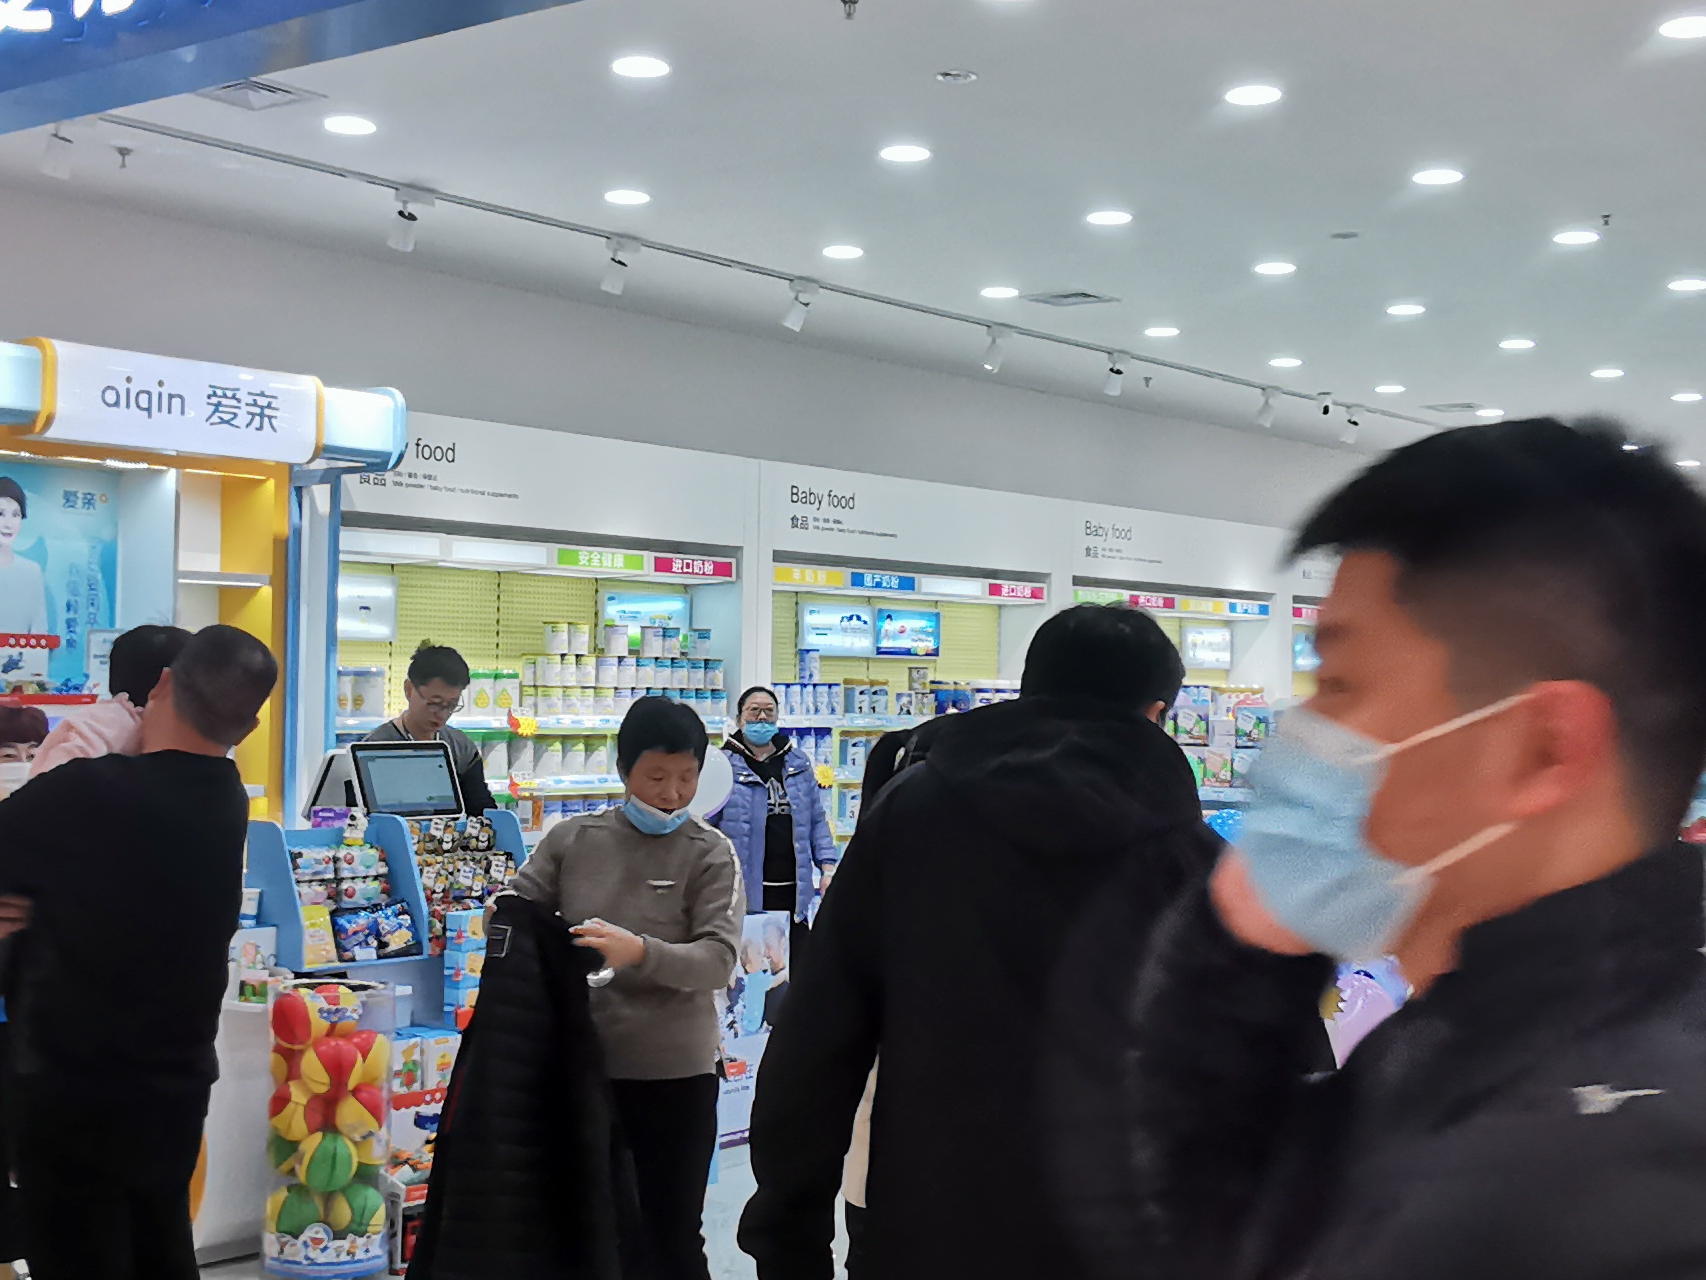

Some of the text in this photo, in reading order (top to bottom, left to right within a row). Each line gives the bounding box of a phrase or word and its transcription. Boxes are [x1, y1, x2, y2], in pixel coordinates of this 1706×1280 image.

[101, 375, 280, 433] aiqin 爱亲
[415, 437, 456, 463] food
[62, 489, 97, 511] 爱亲
[790, 485, 855, 511] Baby food
[790, 515, 809, 530] 食品
[1085, 520, 1132, 542] Baby food
[578, 551, 625, 569] 安全健康
[671, 558, 714, 575] 进口奶粉
[864, 573, 899, 589] 国产奶粉
